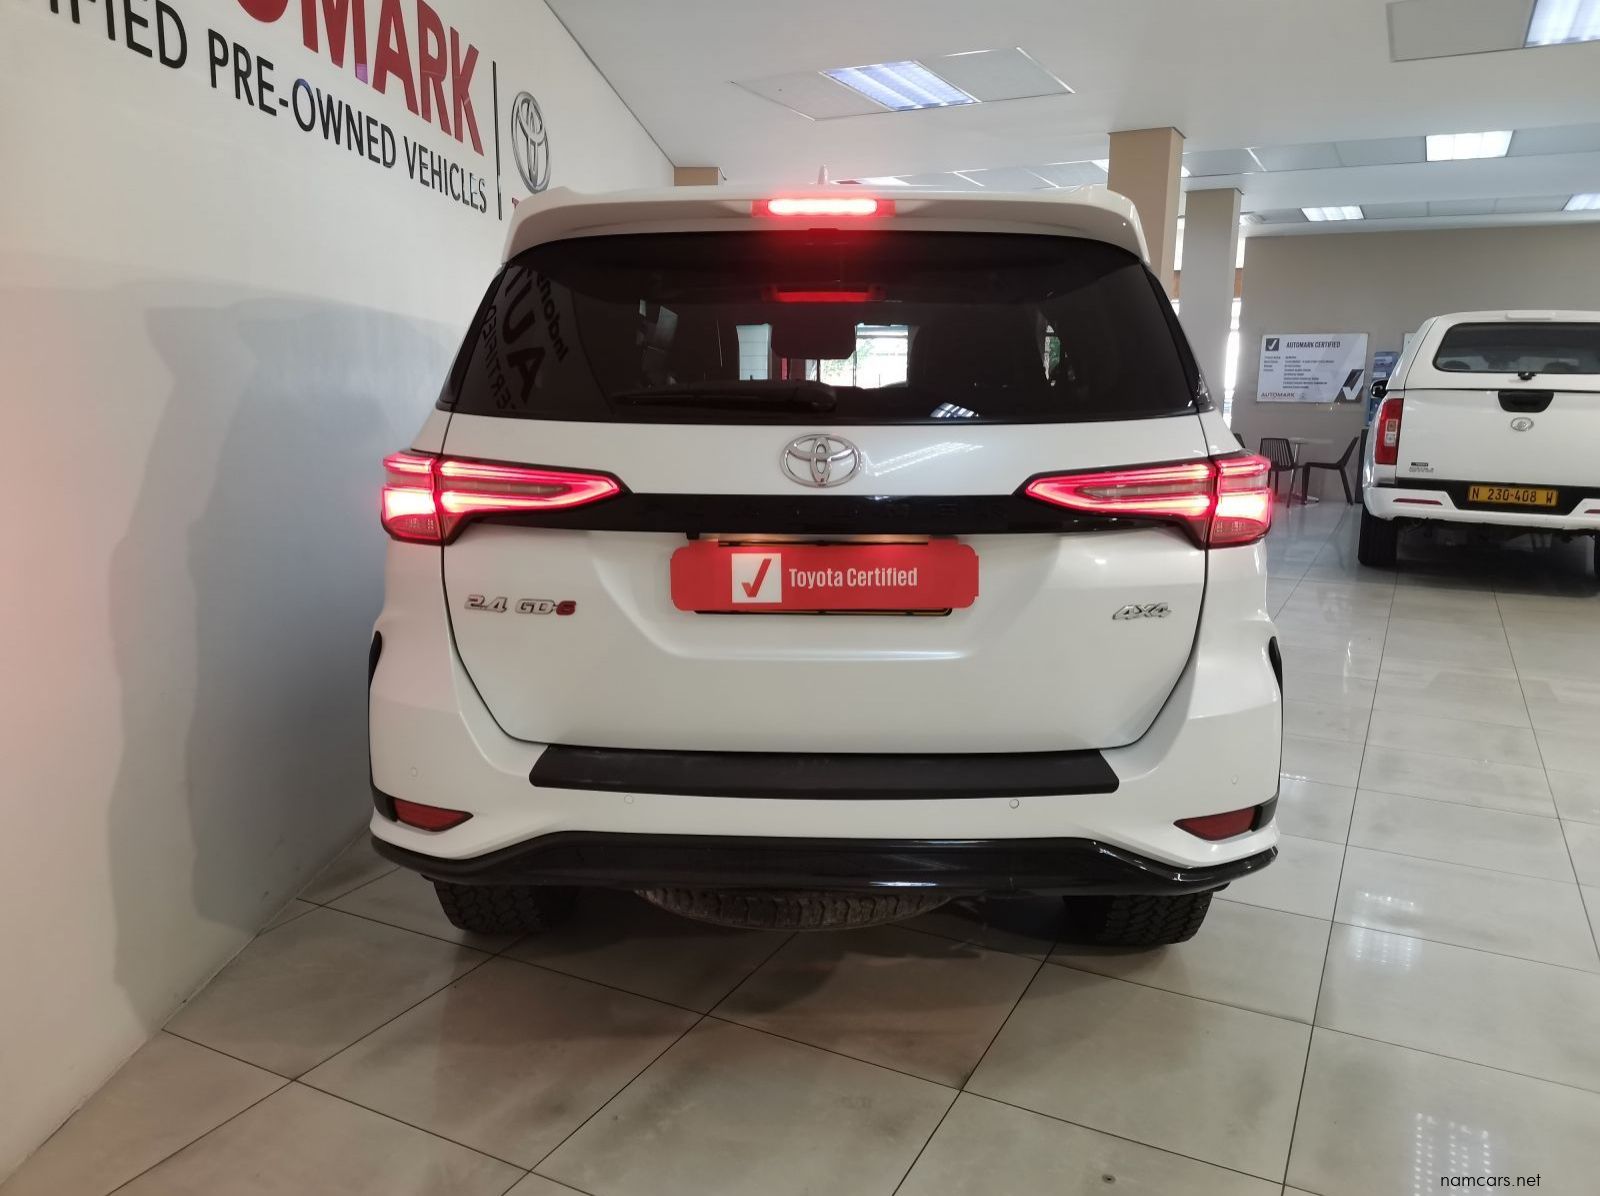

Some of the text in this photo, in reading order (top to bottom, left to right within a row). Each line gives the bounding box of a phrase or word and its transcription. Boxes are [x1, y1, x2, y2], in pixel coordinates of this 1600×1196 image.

[235, 0, 485, 157] MARK
[208, 28, 397, 169] PRE-OWNED
[403, 135, 487, 214] VEHICLES
[1286, 341, 1314, 349] AUTOMARK
[1472, 487, 1554, 505] N 230-408 W
[789, 567, 918, 589] Toyota Certified
